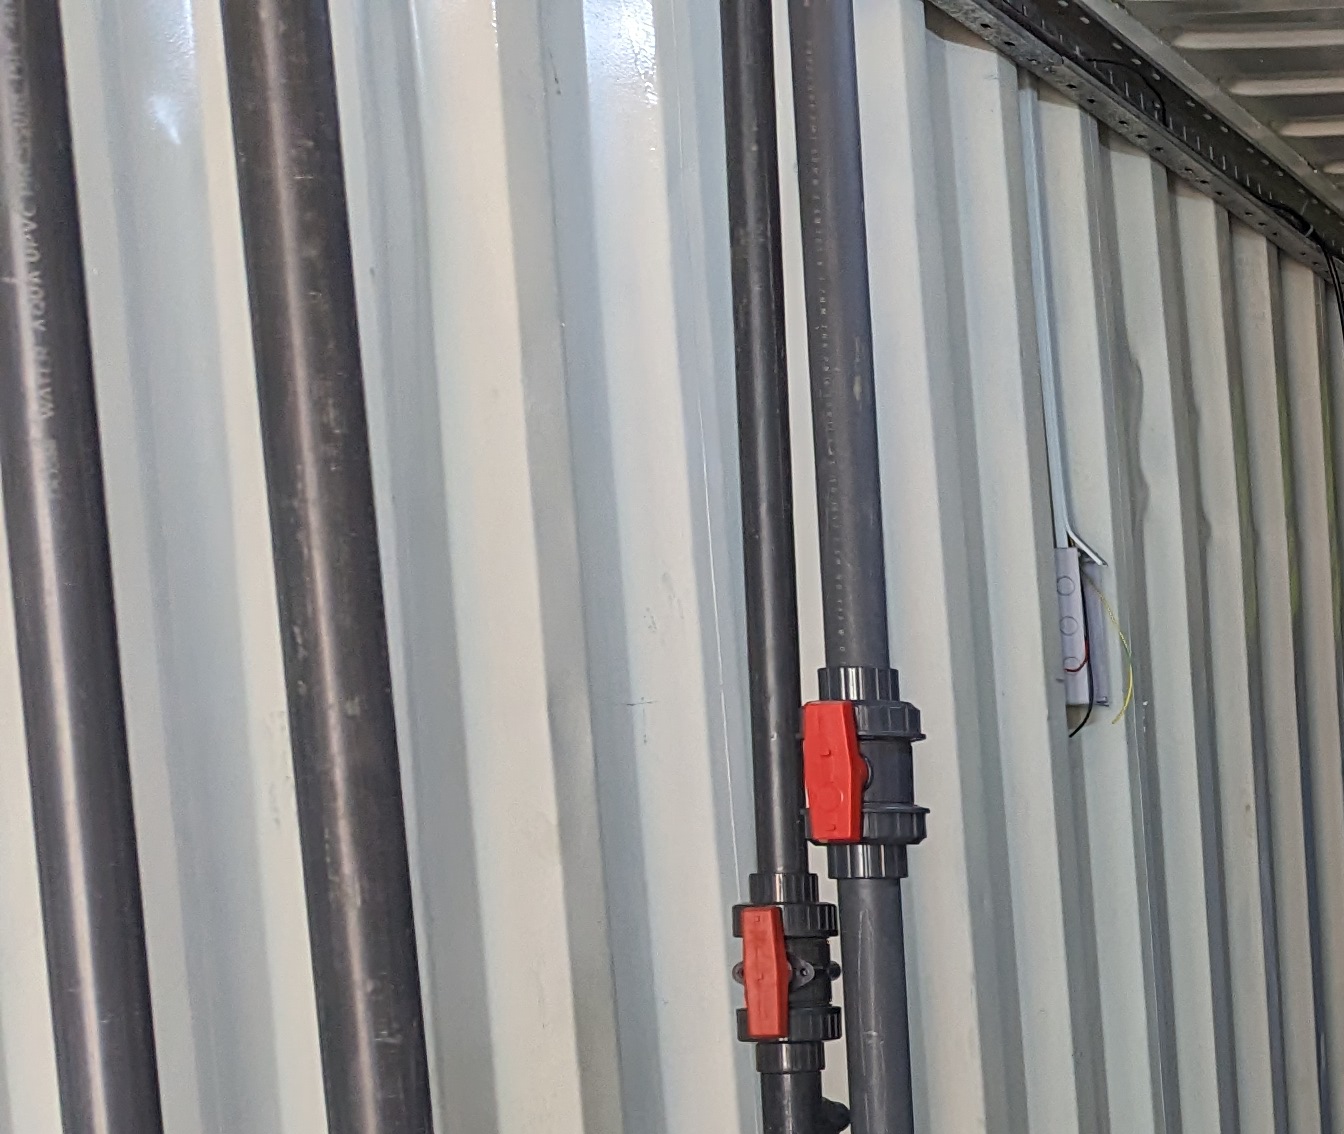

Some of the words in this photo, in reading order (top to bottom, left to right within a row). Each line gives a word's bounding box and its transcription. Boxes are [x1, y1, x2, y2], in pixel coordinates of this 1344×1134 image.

[21, 194, 41, 263] UPVC
[28, 271, 46, 331] AQUA
[34, 346, 55, 420] WATER
